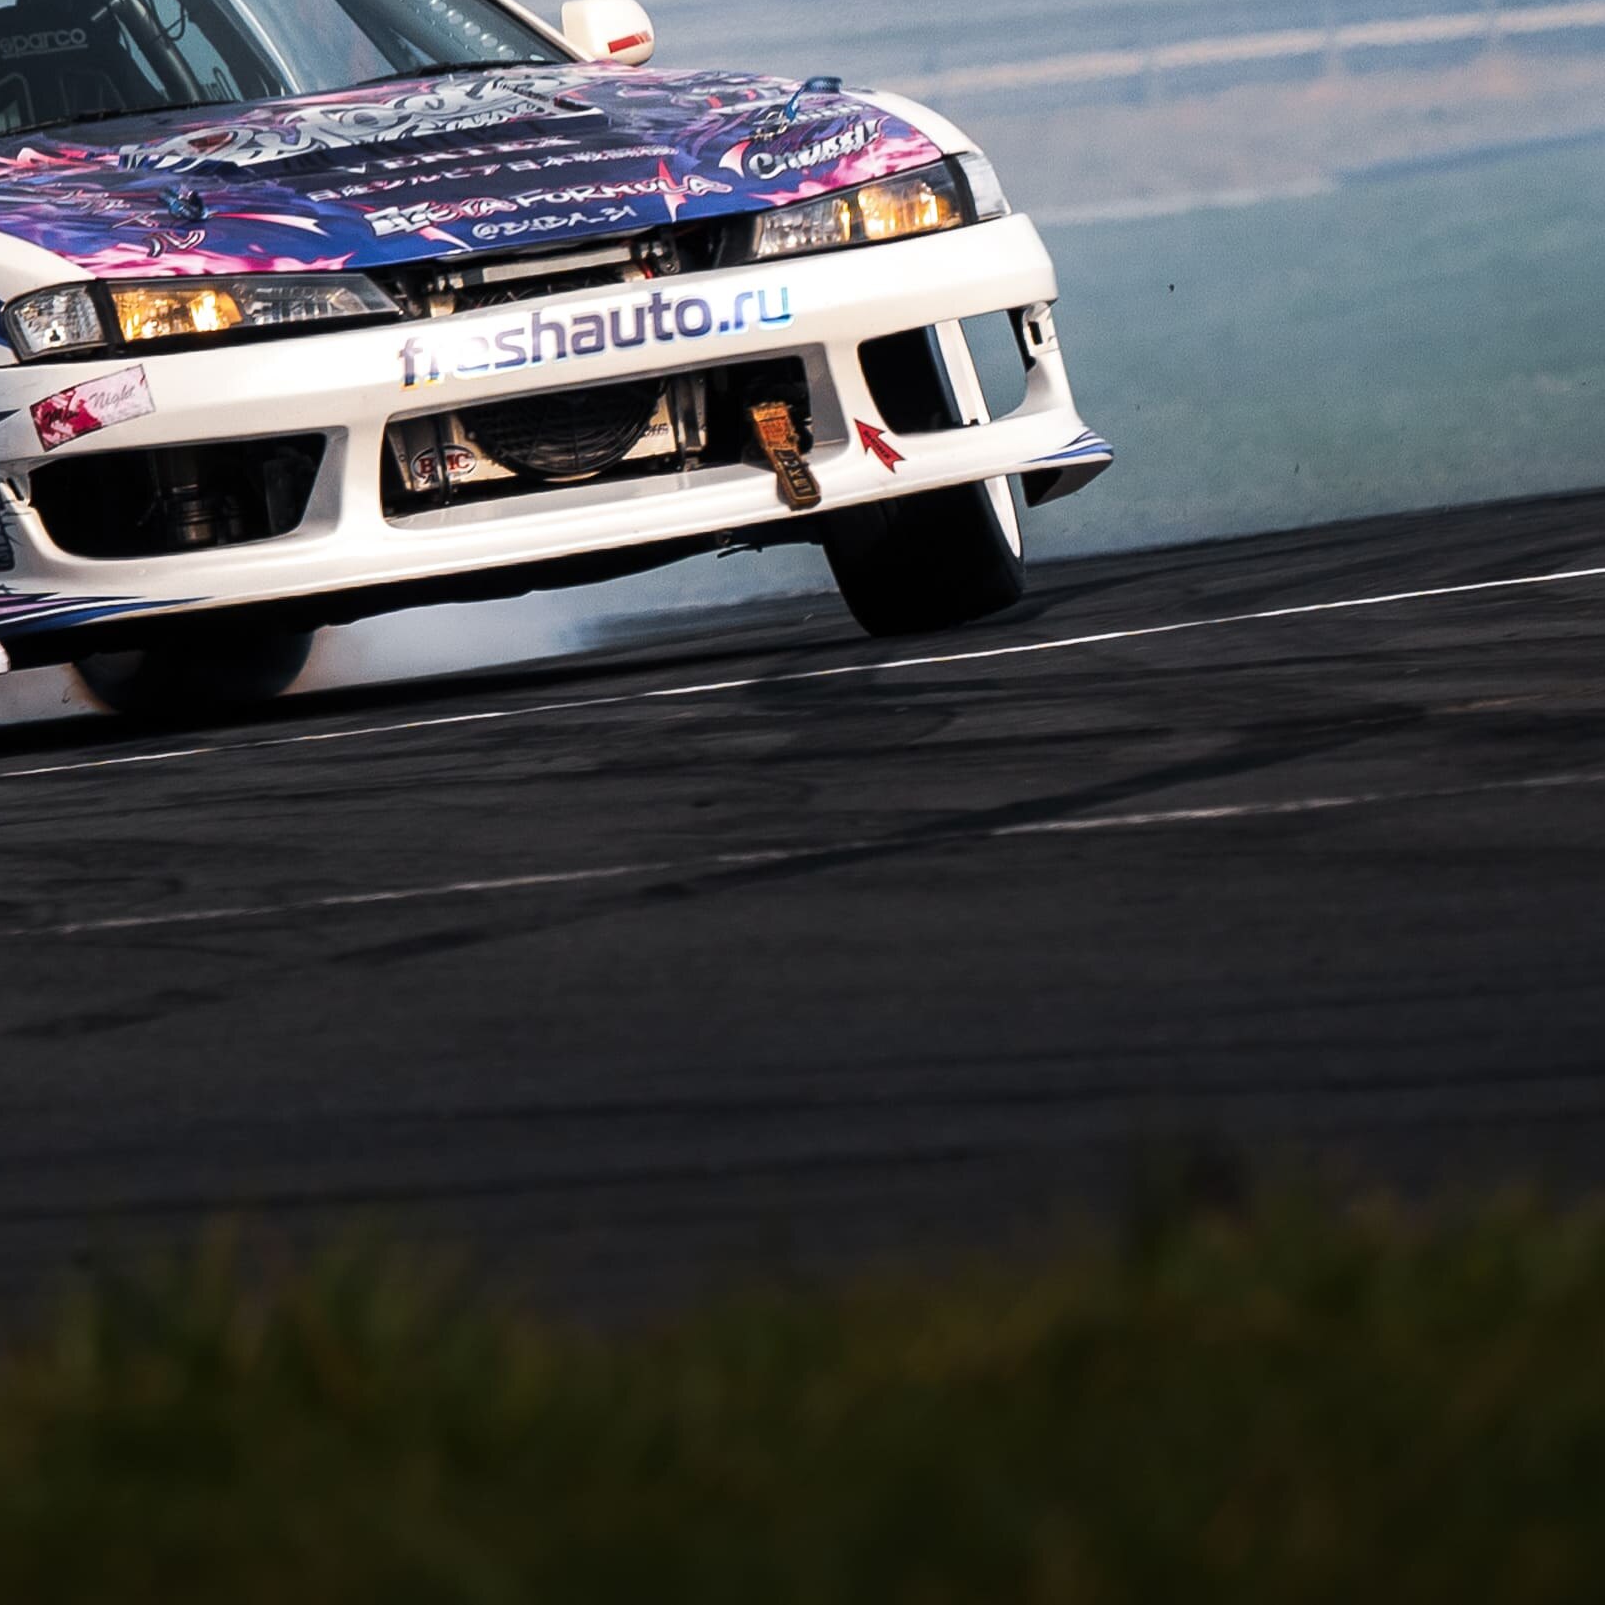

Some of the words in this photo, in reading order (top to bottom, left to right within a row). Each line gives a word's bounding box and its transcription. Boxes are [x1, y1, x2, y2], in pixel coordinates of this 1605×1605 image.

[0, 28, 87, 58] sparco
[514, 175, 733, 207] FORMULA
[399, 287, 792, 386] freshauto.ru
